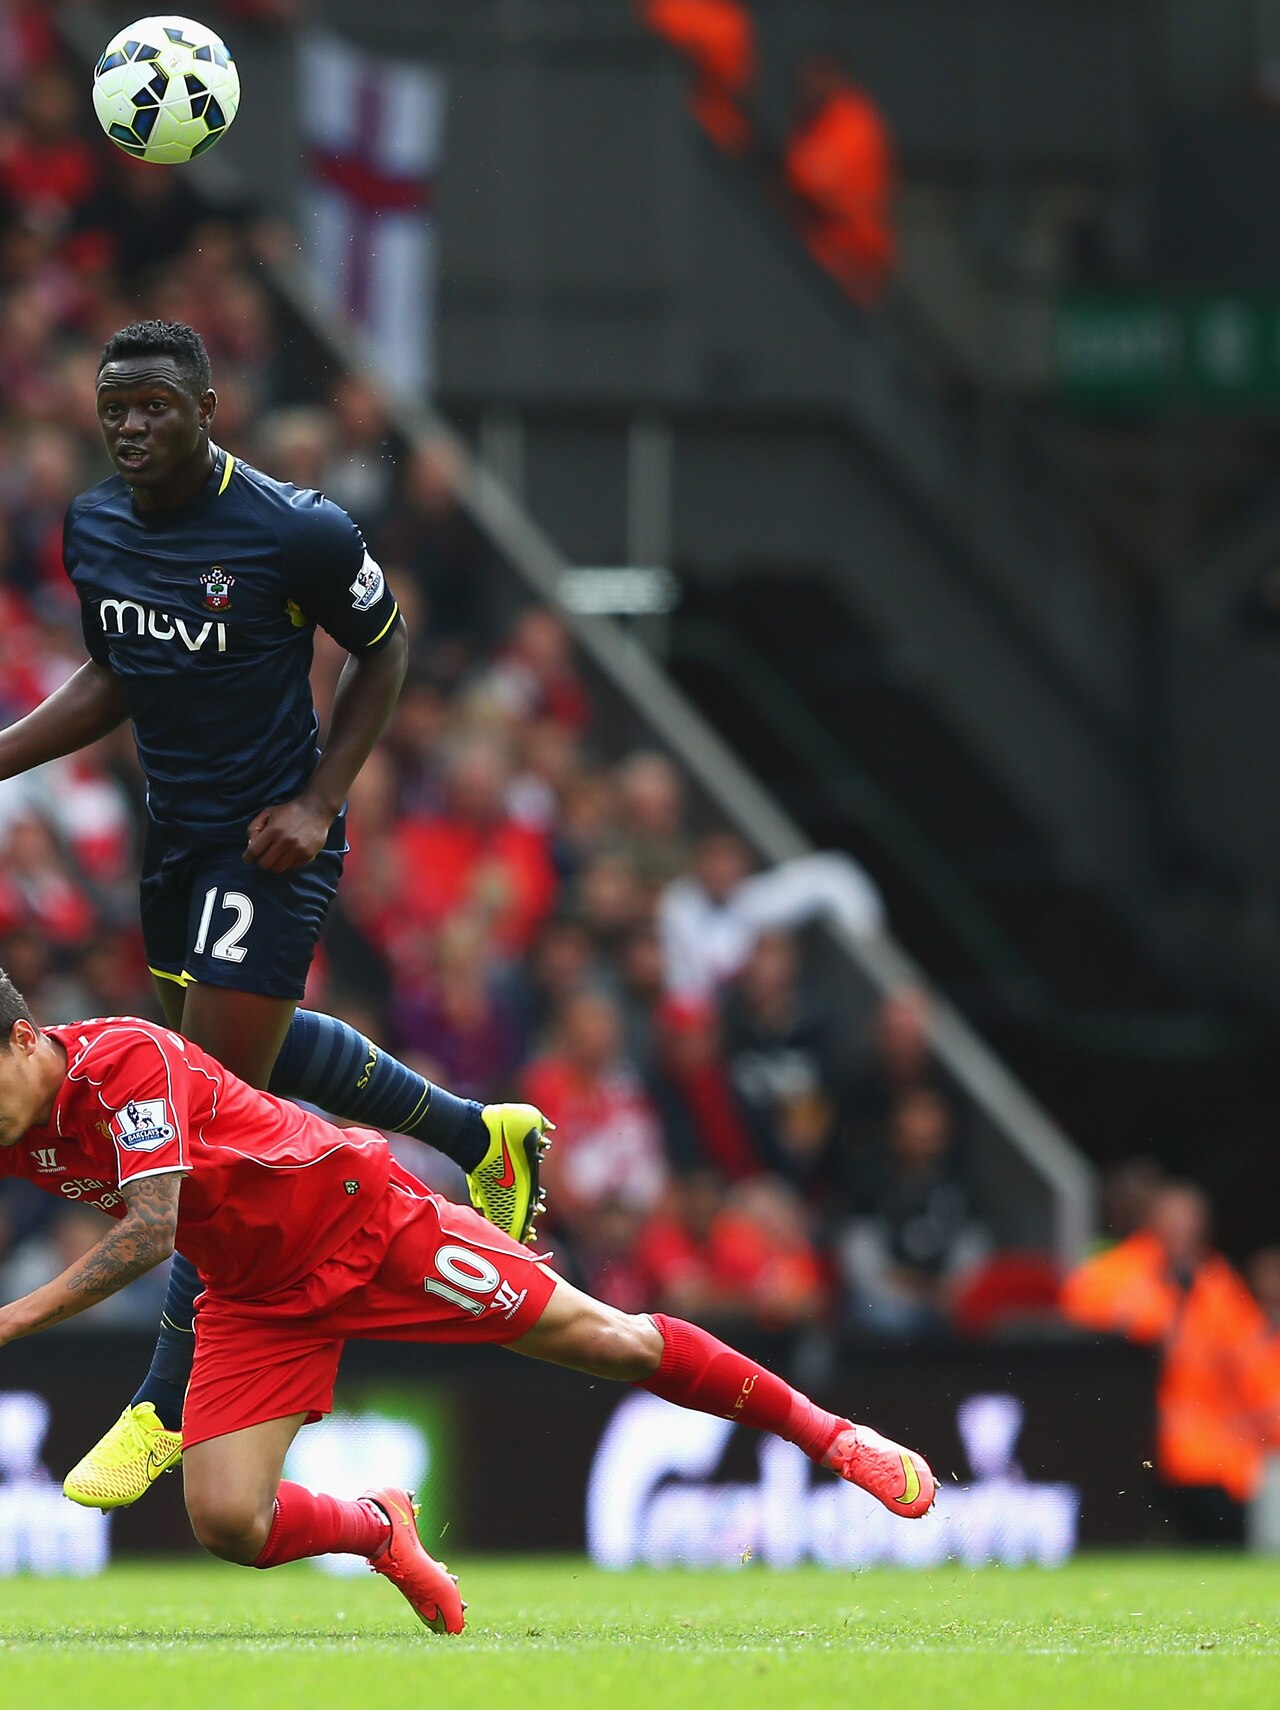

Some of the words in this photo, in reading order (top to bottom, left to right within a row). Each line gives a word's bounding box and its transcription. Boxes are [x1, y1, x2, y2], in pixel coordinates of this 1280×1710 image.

[193, 886, 255, 963] 12
[126, 1128, 160, 1142] BARCLAYS
[424, 1244, 500, 1317] 10
